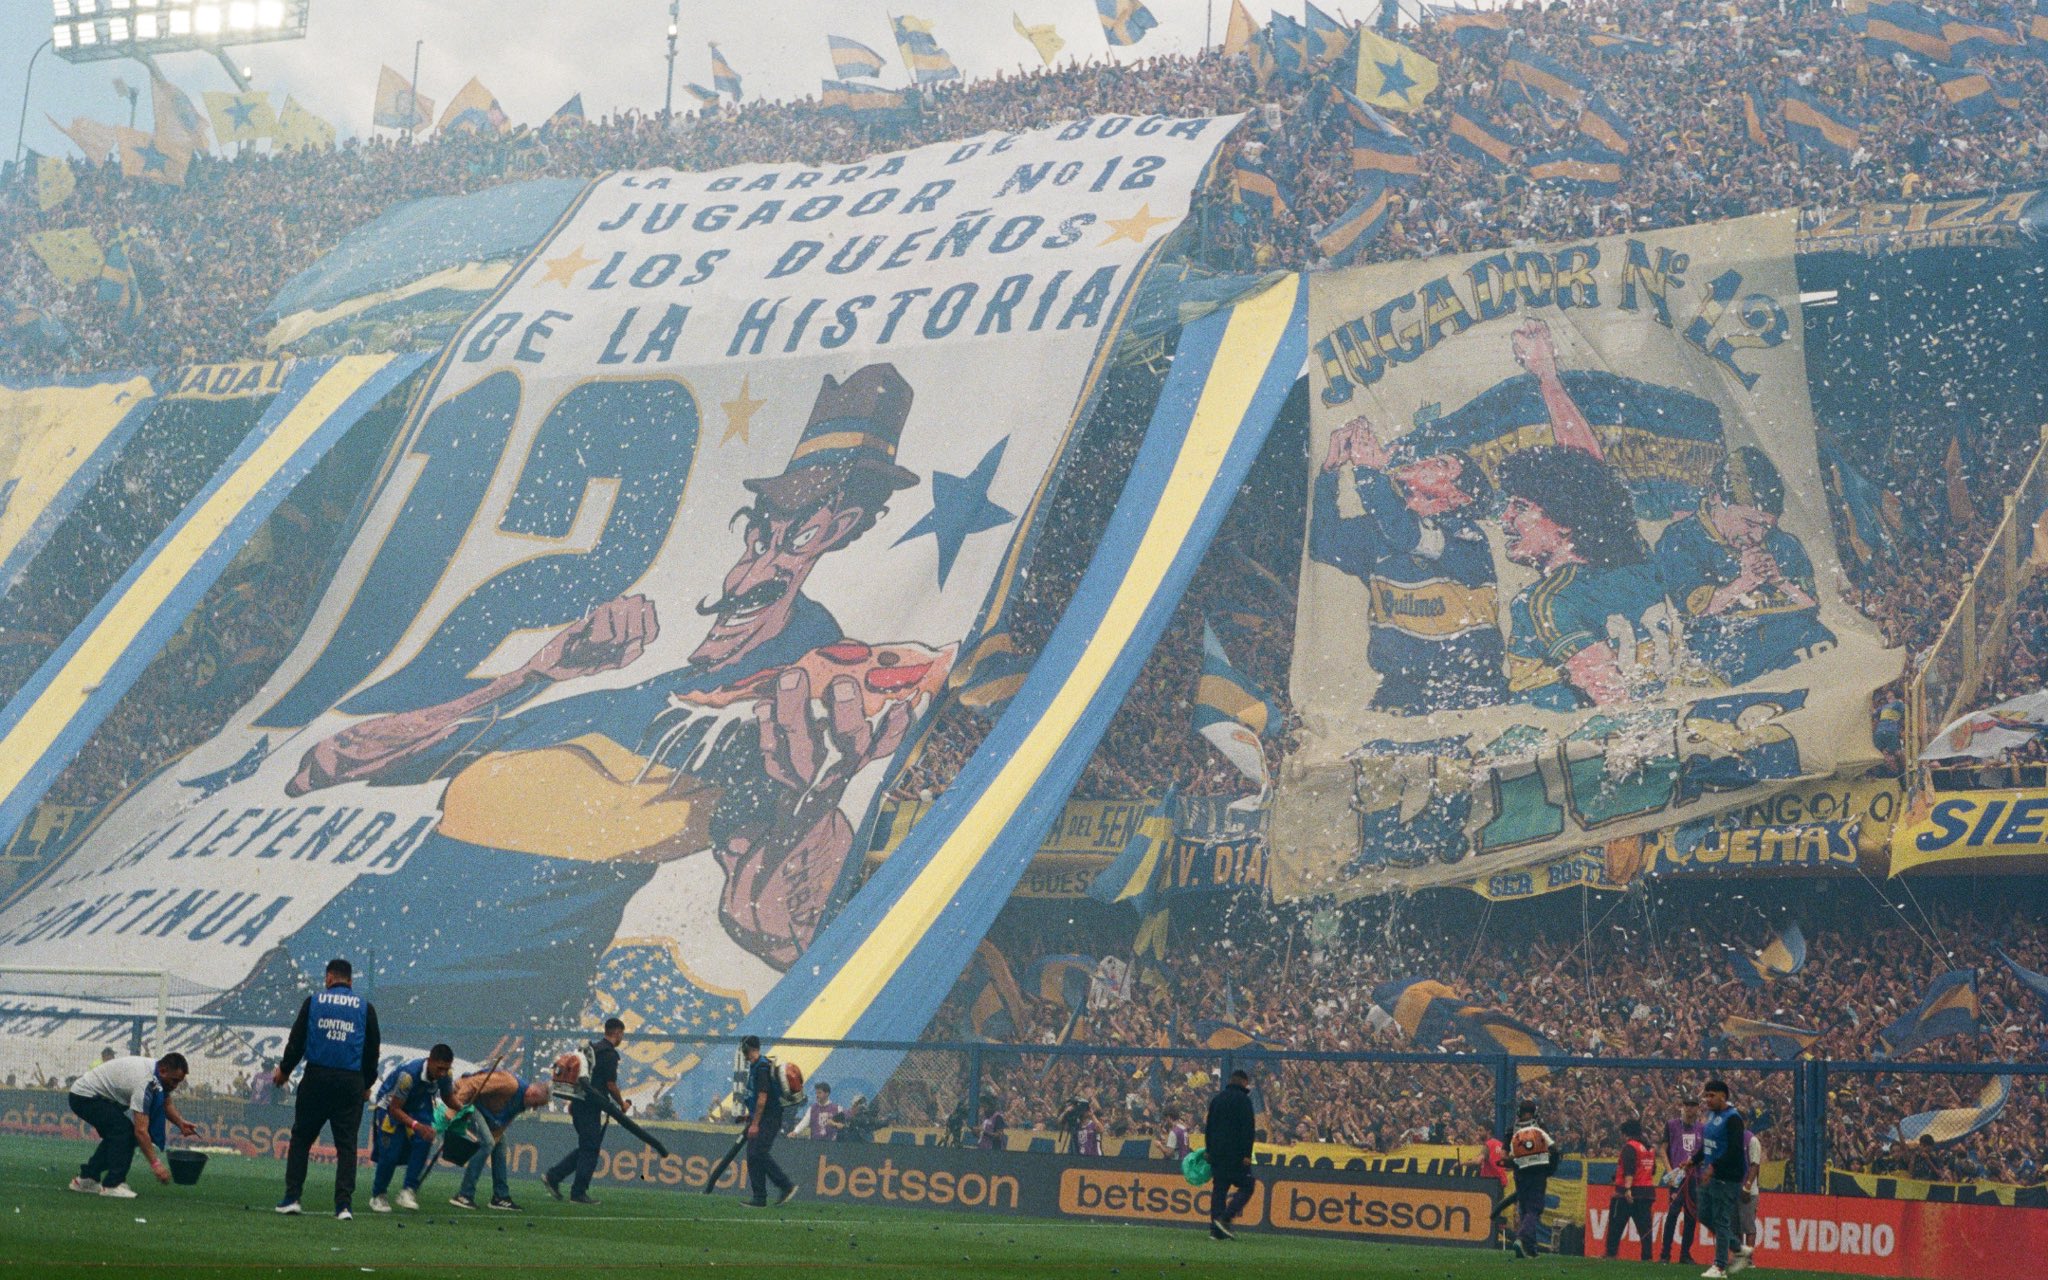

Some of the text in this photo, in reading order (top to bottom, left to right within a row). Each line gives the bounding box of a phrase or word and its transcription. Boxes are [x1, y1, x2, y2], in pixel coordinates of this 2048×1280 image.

[704, 155, 906, 192] BARRA
[1056, 115, 1213, 141] BOCA
[598, 178, 956, 235] JUGADOR
[1796, 190, 2042, 238] ZEIZA
[587, 207, 1098, 291] LOS DUEÑOS
[462, 264, 1123, 365] DE LA HISTORIA
[1312, 243, 1602, 409] JUGADOR
[1684, 268, 1790, 391] 12
[248, 365, 703, 729] 12
[168, 805, 435, 869] LEYENDA
[1915, 798, 2048, 852] SIE
[318, 993, 360, 1008] UTEDYC
[318, 1018, 355, 1033] CONTROL
[816, 1154, 1019, 1208] betsson
[1077, 1175, 1240, 1217] betsso
[1289, 1187, 1470, 1233] betsson
[1786, 1217, 1896, 1257] VIDRIO
